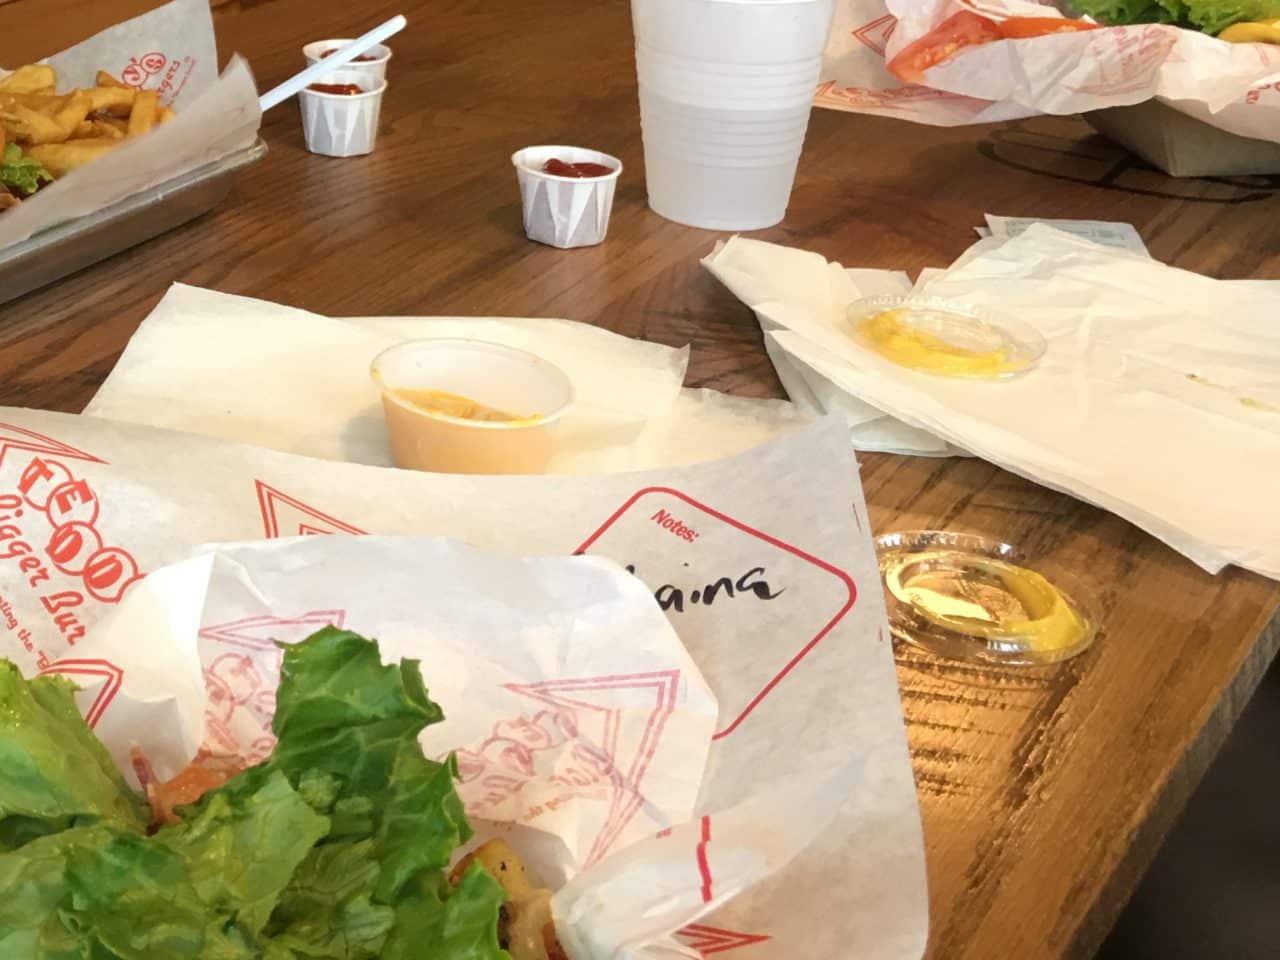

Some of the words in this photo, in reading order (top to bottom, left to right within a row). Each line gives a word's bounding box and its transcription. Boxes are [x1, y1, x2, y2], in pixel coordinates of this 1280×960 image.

[17, 456, 141, 604] TEDD
[650, 509, 700, 543] Notes:
[651, 563, 787, 613] aina
[17, 628, 34, 653] the
[40, 591, 87, 646] Bur
